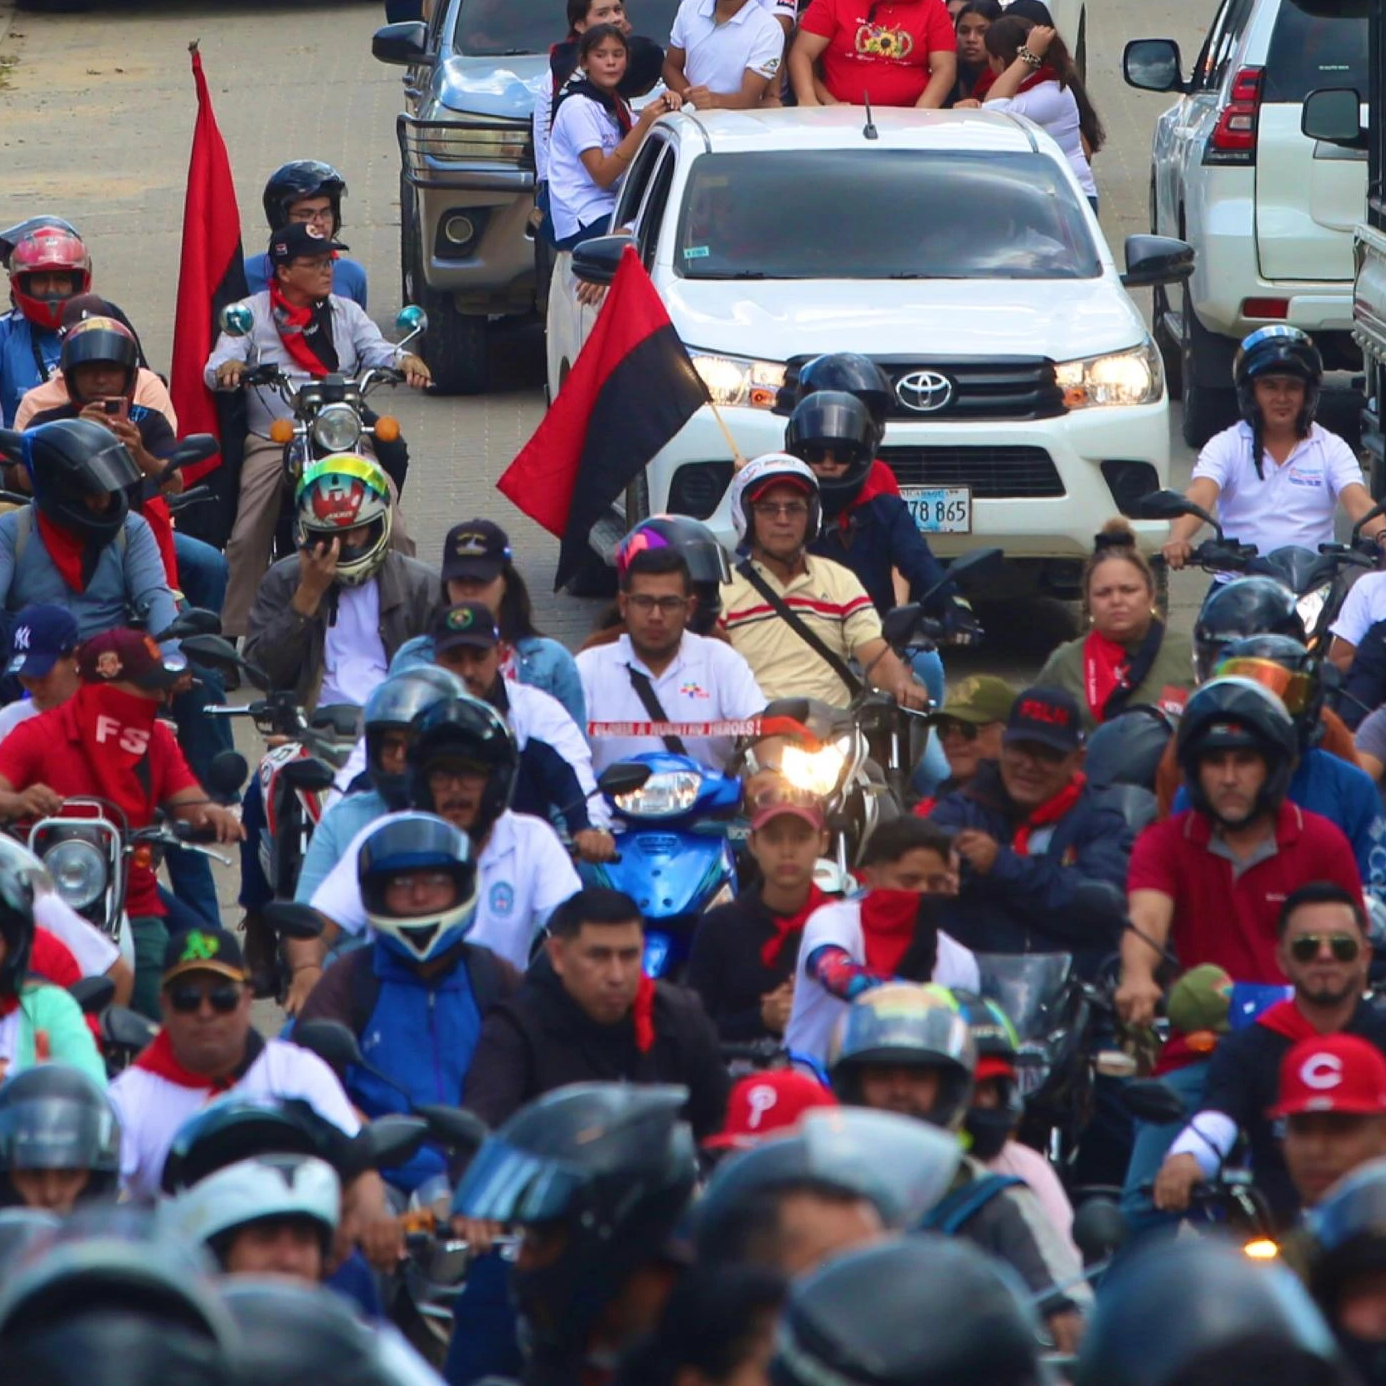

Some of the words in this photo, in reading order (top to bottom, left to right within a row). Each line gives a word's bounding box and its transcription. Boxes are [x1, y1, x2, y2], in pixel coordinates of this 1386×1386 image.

[934, 500, 967, 523] 865
[1300, 1052, 1342, 1089] C
[747, 1084, 777, 1129] P
